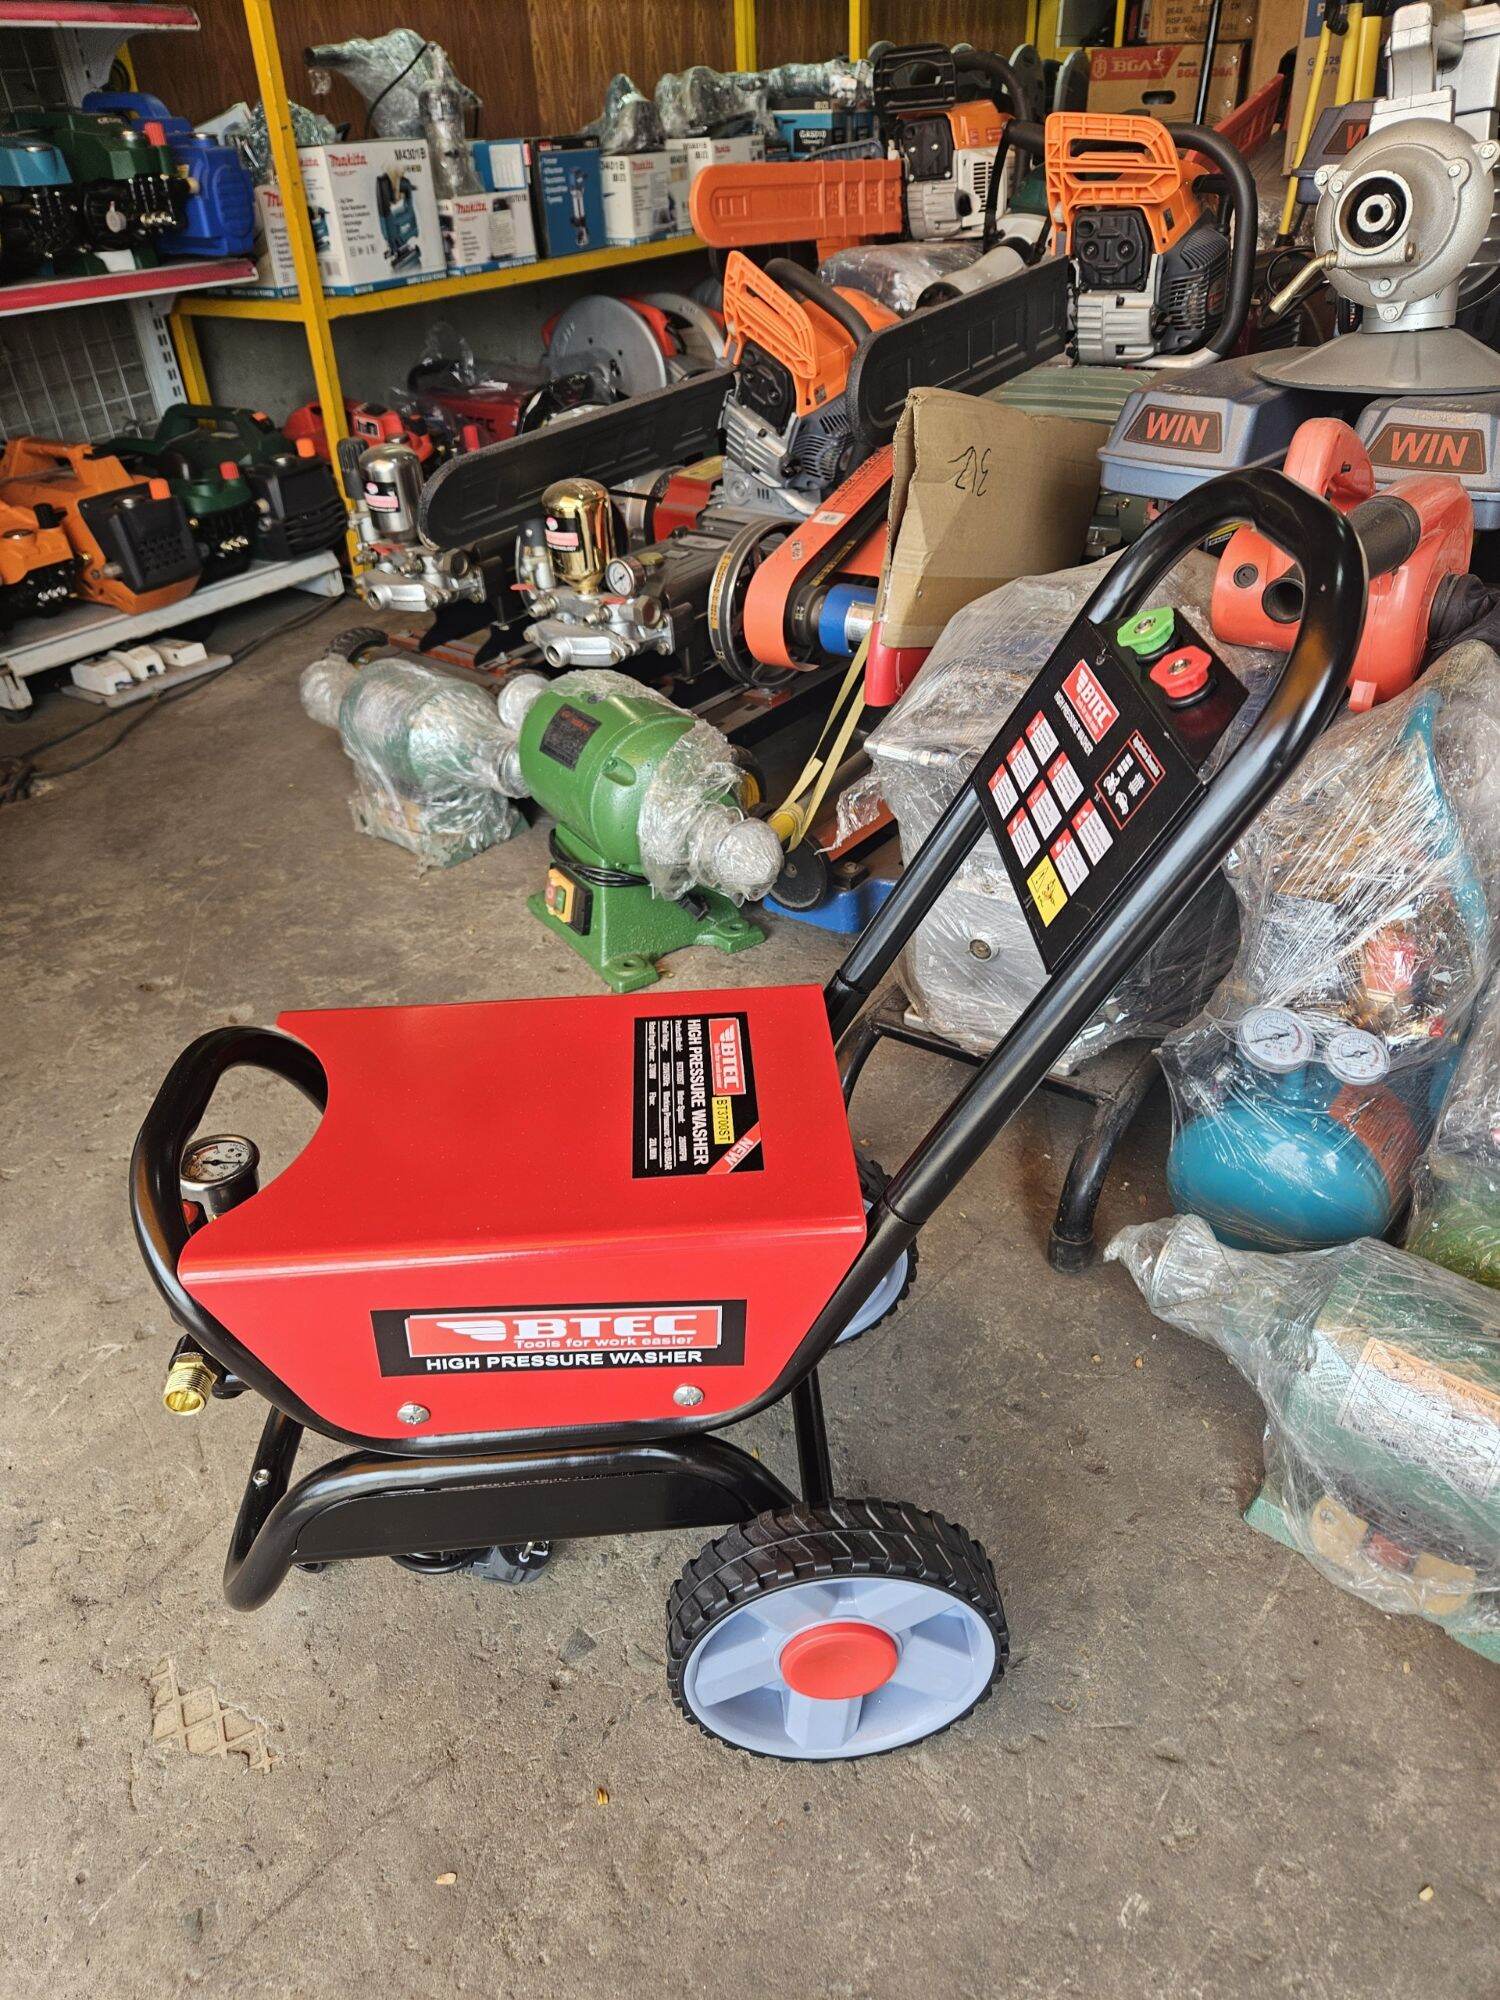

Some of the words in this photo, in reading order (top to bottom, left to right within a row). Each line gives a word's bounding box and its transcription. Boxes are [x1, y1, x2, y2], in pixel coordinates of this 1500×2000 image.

[1149, 411, 1210, 445] WIN
[1390, 431, 1470, 467] WIN
[1078, 682, 1113, 730] BTEC
[688, 1019, 702, 1045] HIGH
[688, 1047, 706, 1108] PRESSURE
[721, 1041, 740, 1089] BTEC
[692, 1109, 709, 1166] WASHER
[717, 1099, 730, 1141] BT3700ST
[724, 1137, 753, 1166] NEW
[512, 1314, 697, 1340] BTEC
[514, 1338, 560, 1349] Tools
[565, 1337, 591, 1348] for
[595, 1336, 638, 1347] work
[642, 1335, 694, 1345] easier
[426, 1358, 481, 1371] HIGH
[486, 1352, 605, 1369] PRESSURE
[609, 1350, 703, 1366] WASHER
